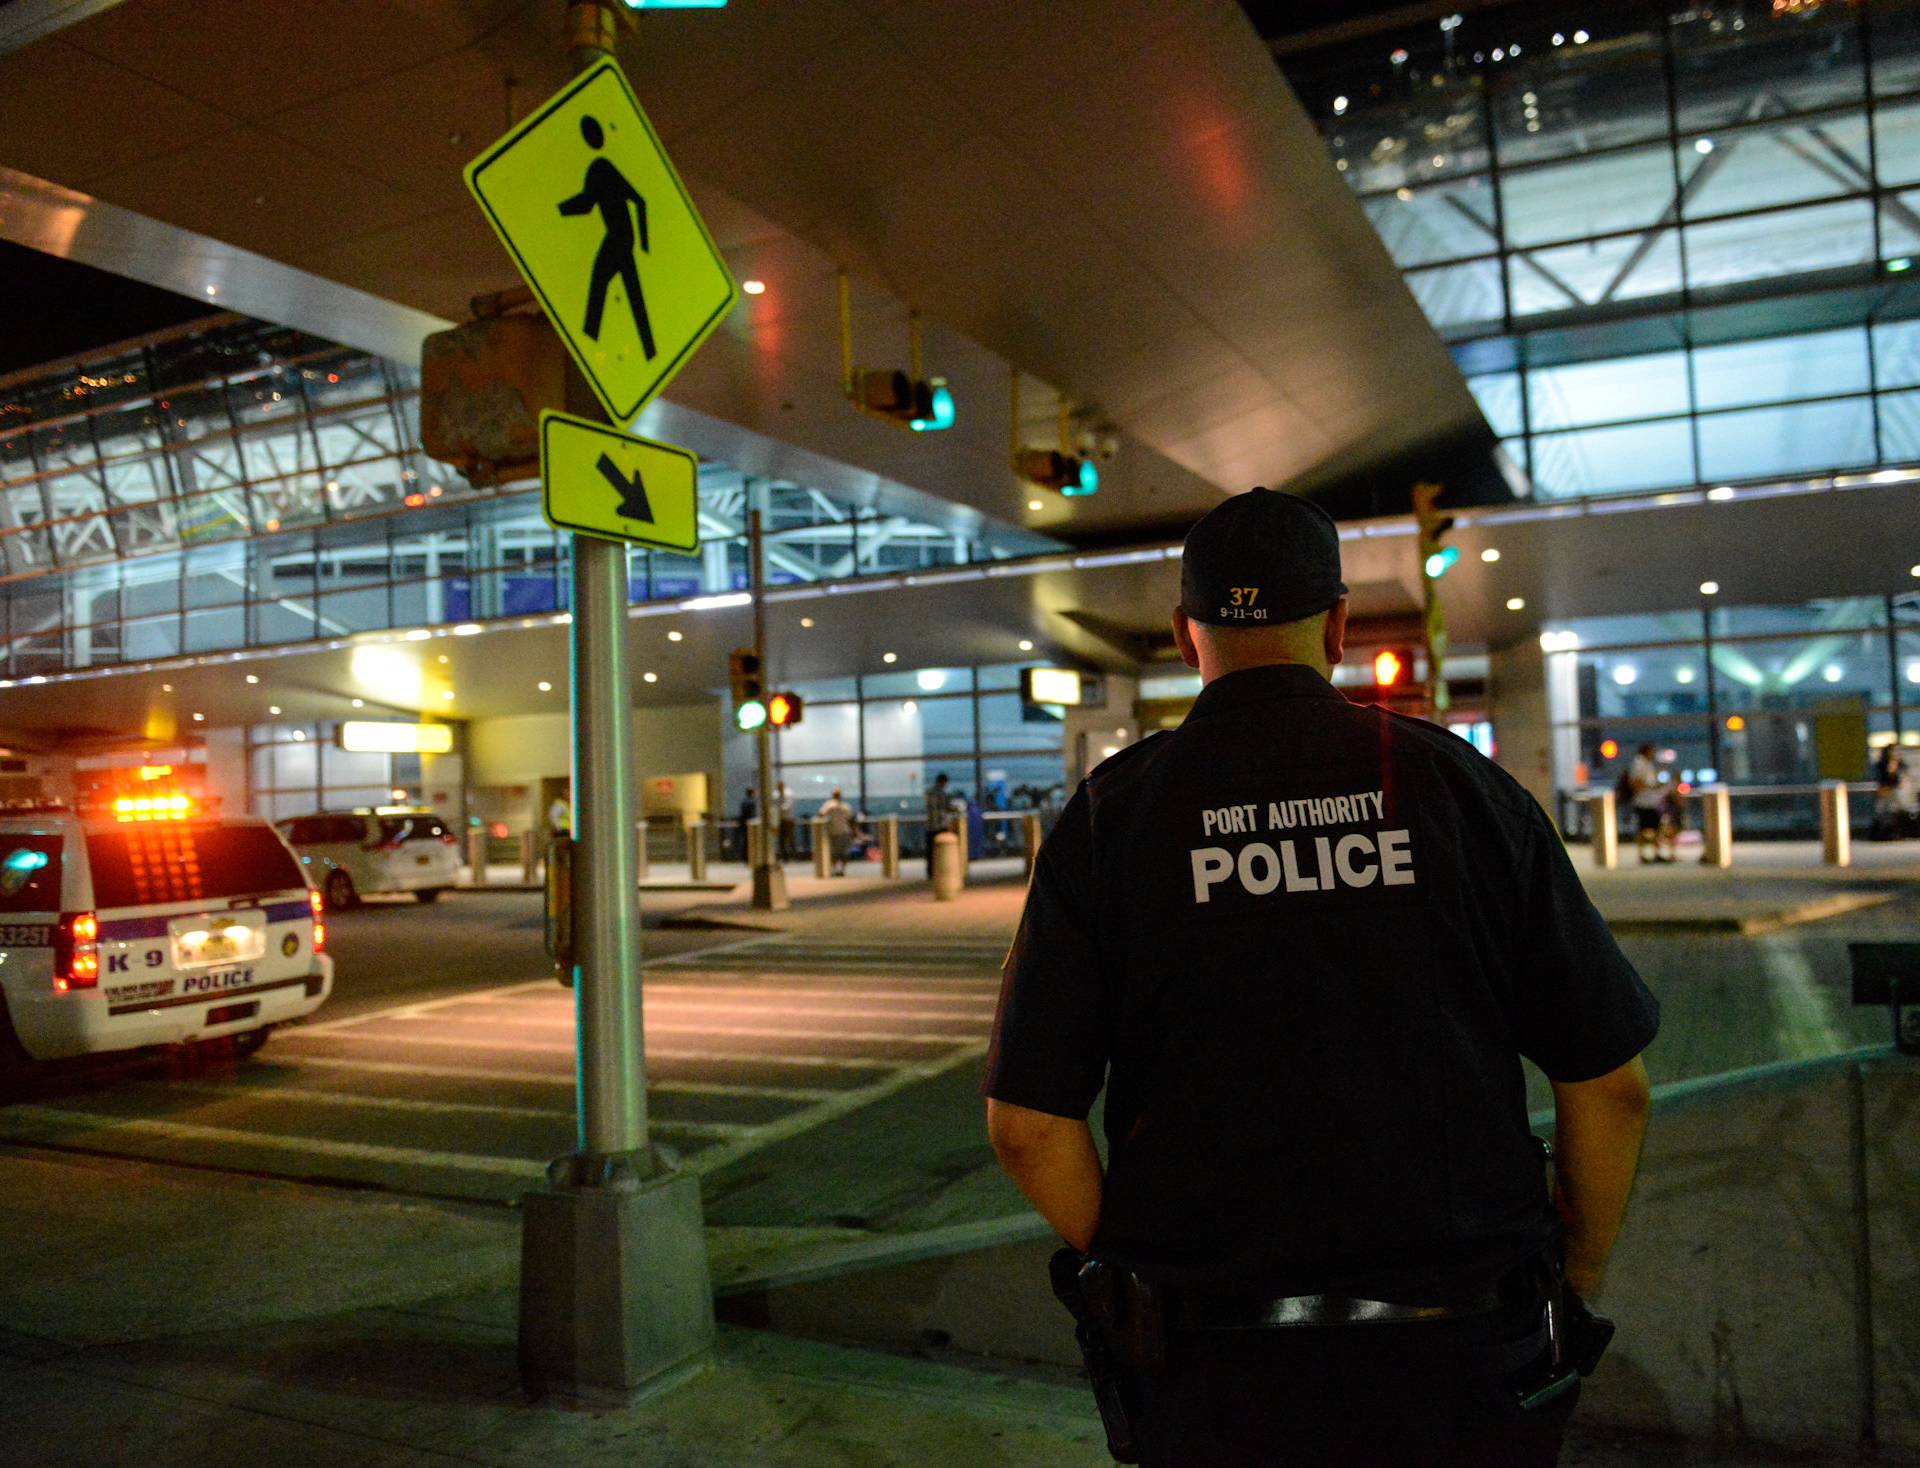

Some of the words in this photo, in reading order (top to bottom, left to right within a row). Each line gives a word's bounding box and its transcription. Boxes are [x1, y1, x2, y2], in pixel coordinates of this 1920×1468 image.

[1230, 587, 1259, 606] 37
[1220, 608, 1268, 619] 9-11-01
[1202, 804, 1257, 836] PORT
[1269, 791, 1384, 830] AUTHORITY
[1190, 829, 1416, 904] POLICE
[183, 969, 254, 993] POLICE
